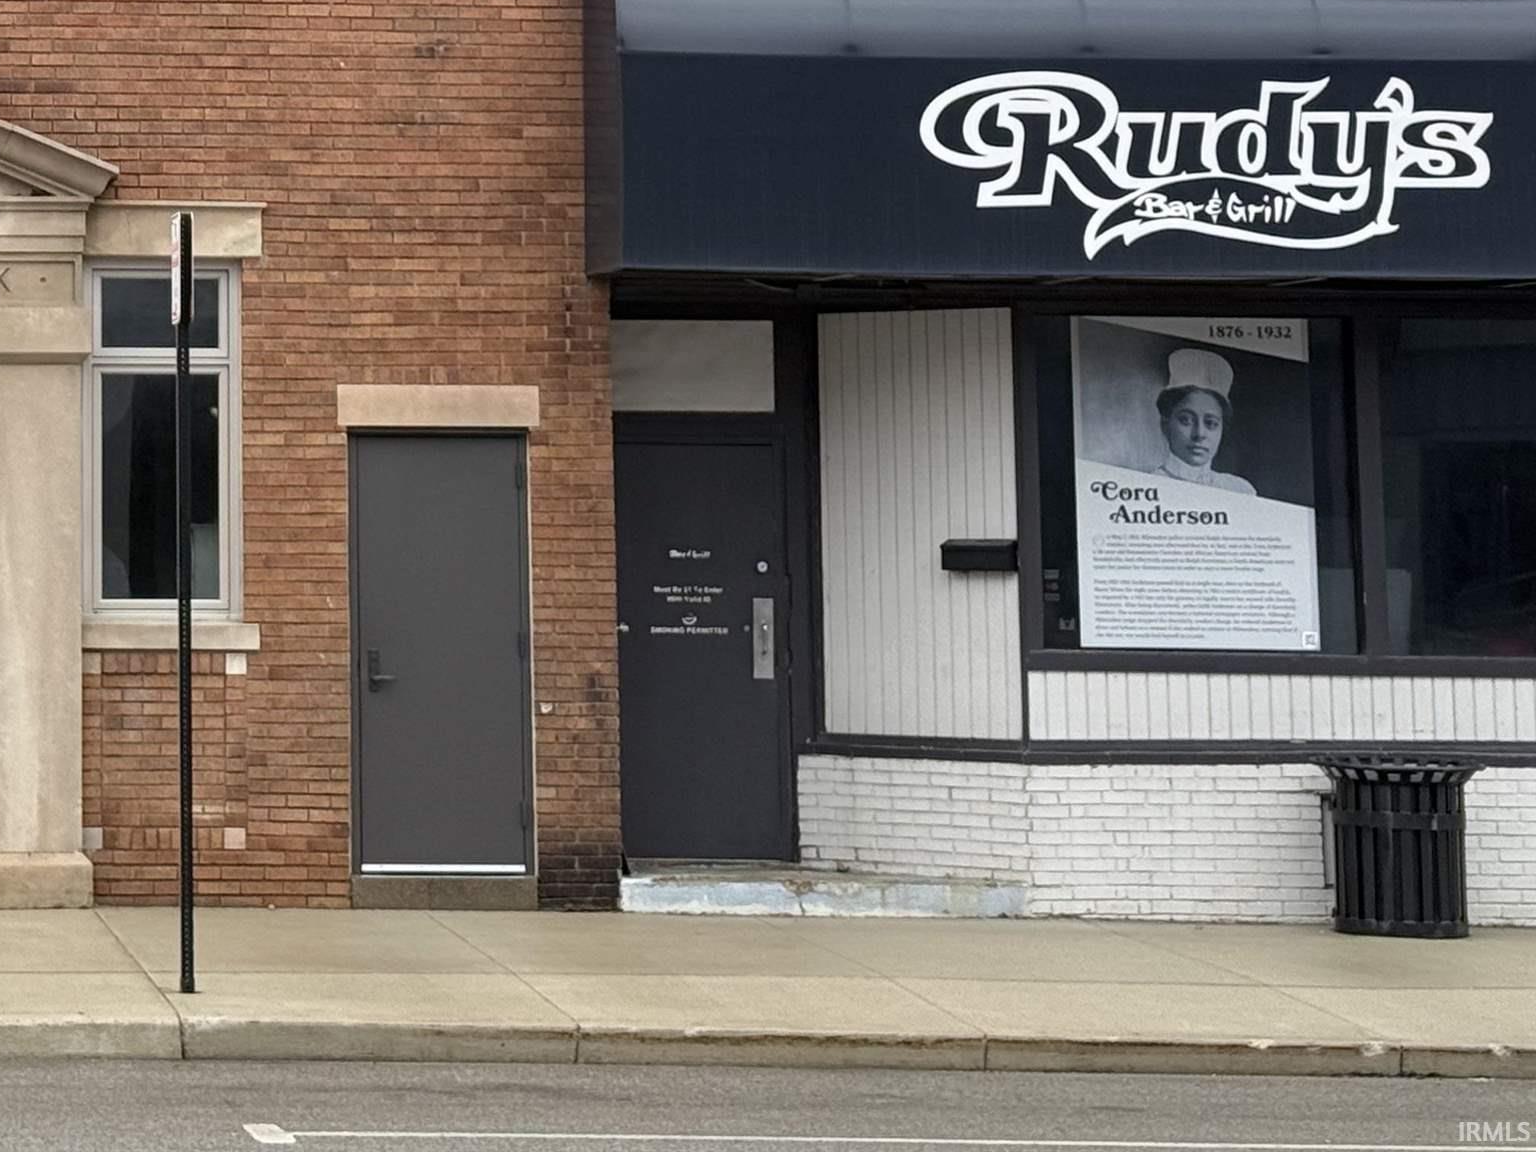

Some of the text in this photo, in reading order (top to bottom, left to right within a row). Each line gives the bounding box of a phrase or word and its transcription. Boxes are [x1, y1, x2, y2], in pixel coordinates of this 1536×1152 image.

[919, 70, 1494, 254] Rudy's
[1133, 187, 1296, 224] Bar & Grill
[1208, 325, 1244, 339] 1876
[1256, 325, 1292, 339] 1932
[1090, 481, 1159, 502] Cora
[1109, 504, 1229, 525] Anderson
